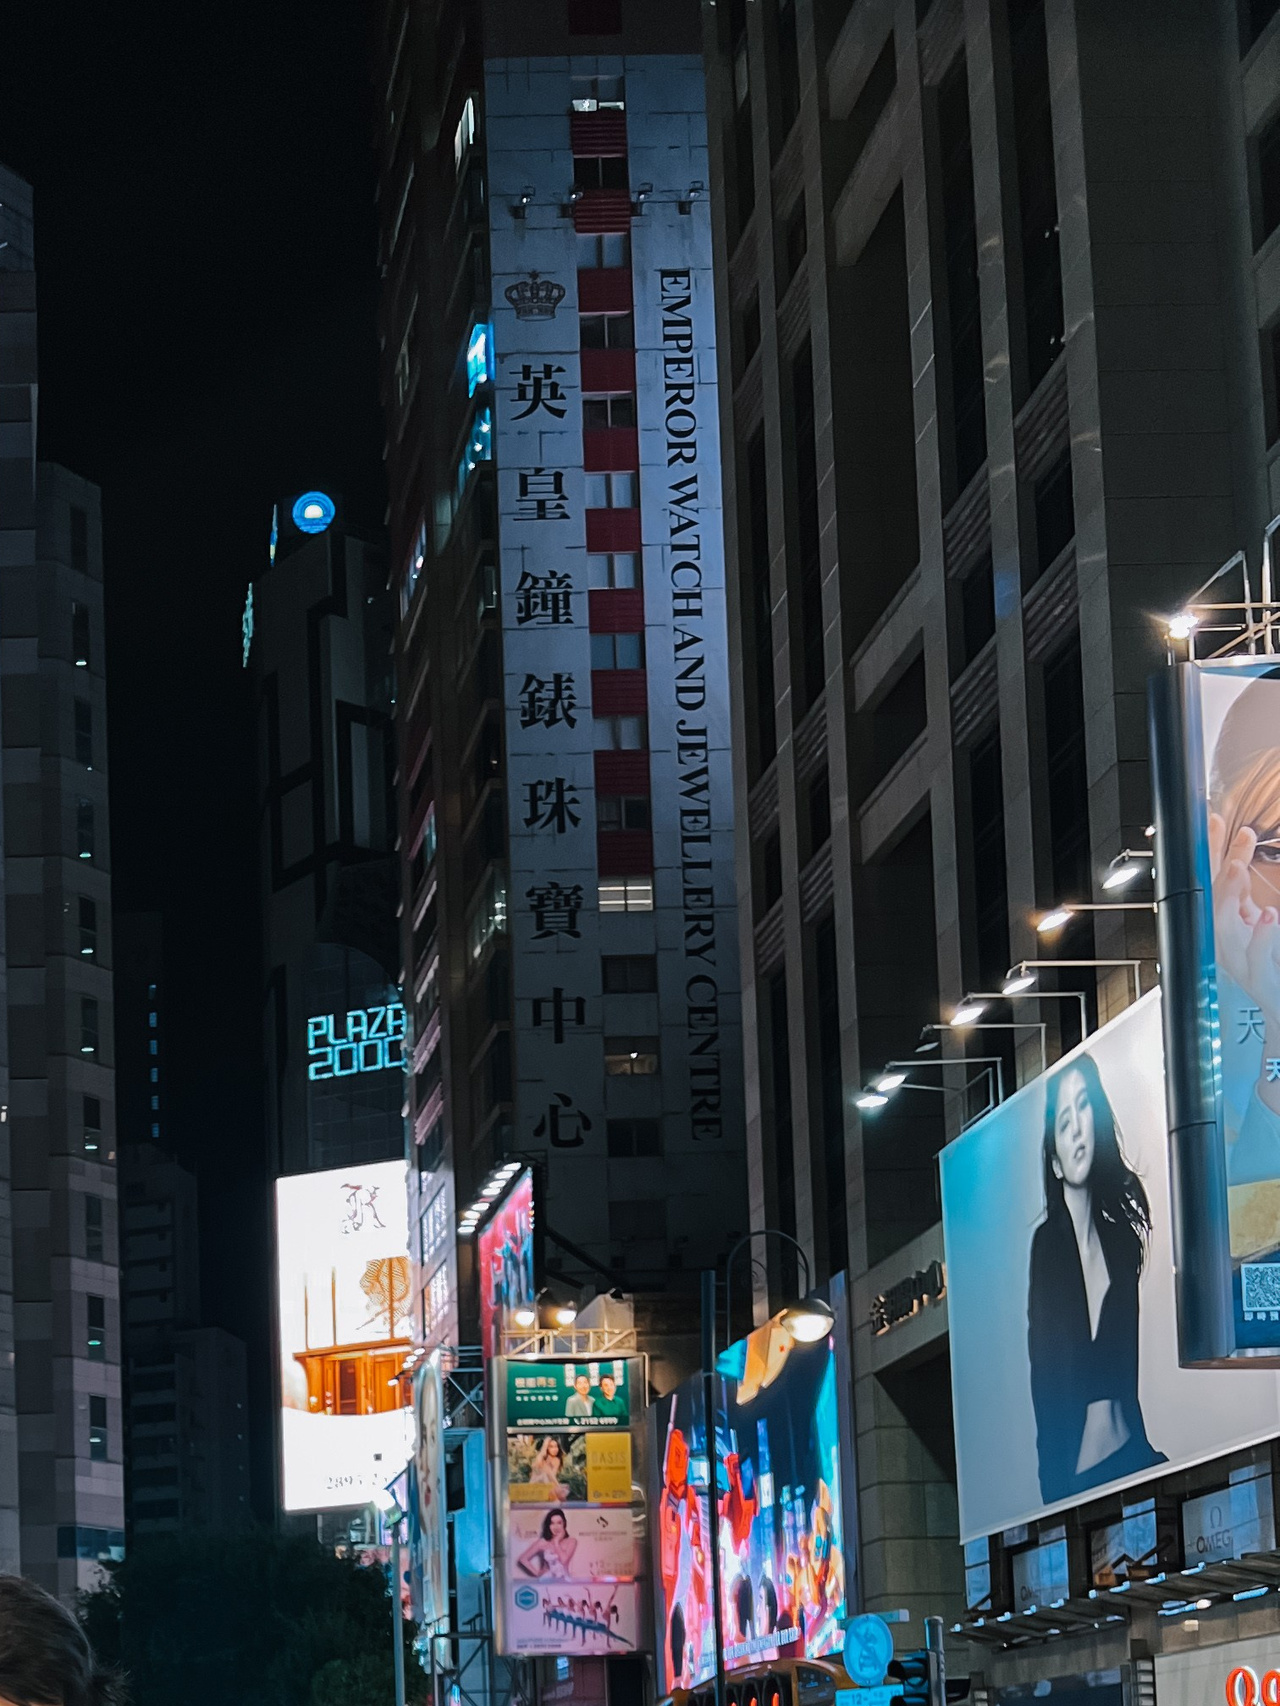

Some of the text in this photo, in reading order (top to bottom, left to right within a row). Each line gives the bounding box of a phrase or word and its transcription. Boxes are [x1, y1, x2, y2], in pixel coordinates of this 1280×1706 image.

[659, 267, 723, 1141] EMPEROR WATCH AND JEWELLERY CENTRE
[307, 1003, 407, 1049] PLAZA
[1196, 1529, 1233, 1554] OMEG
